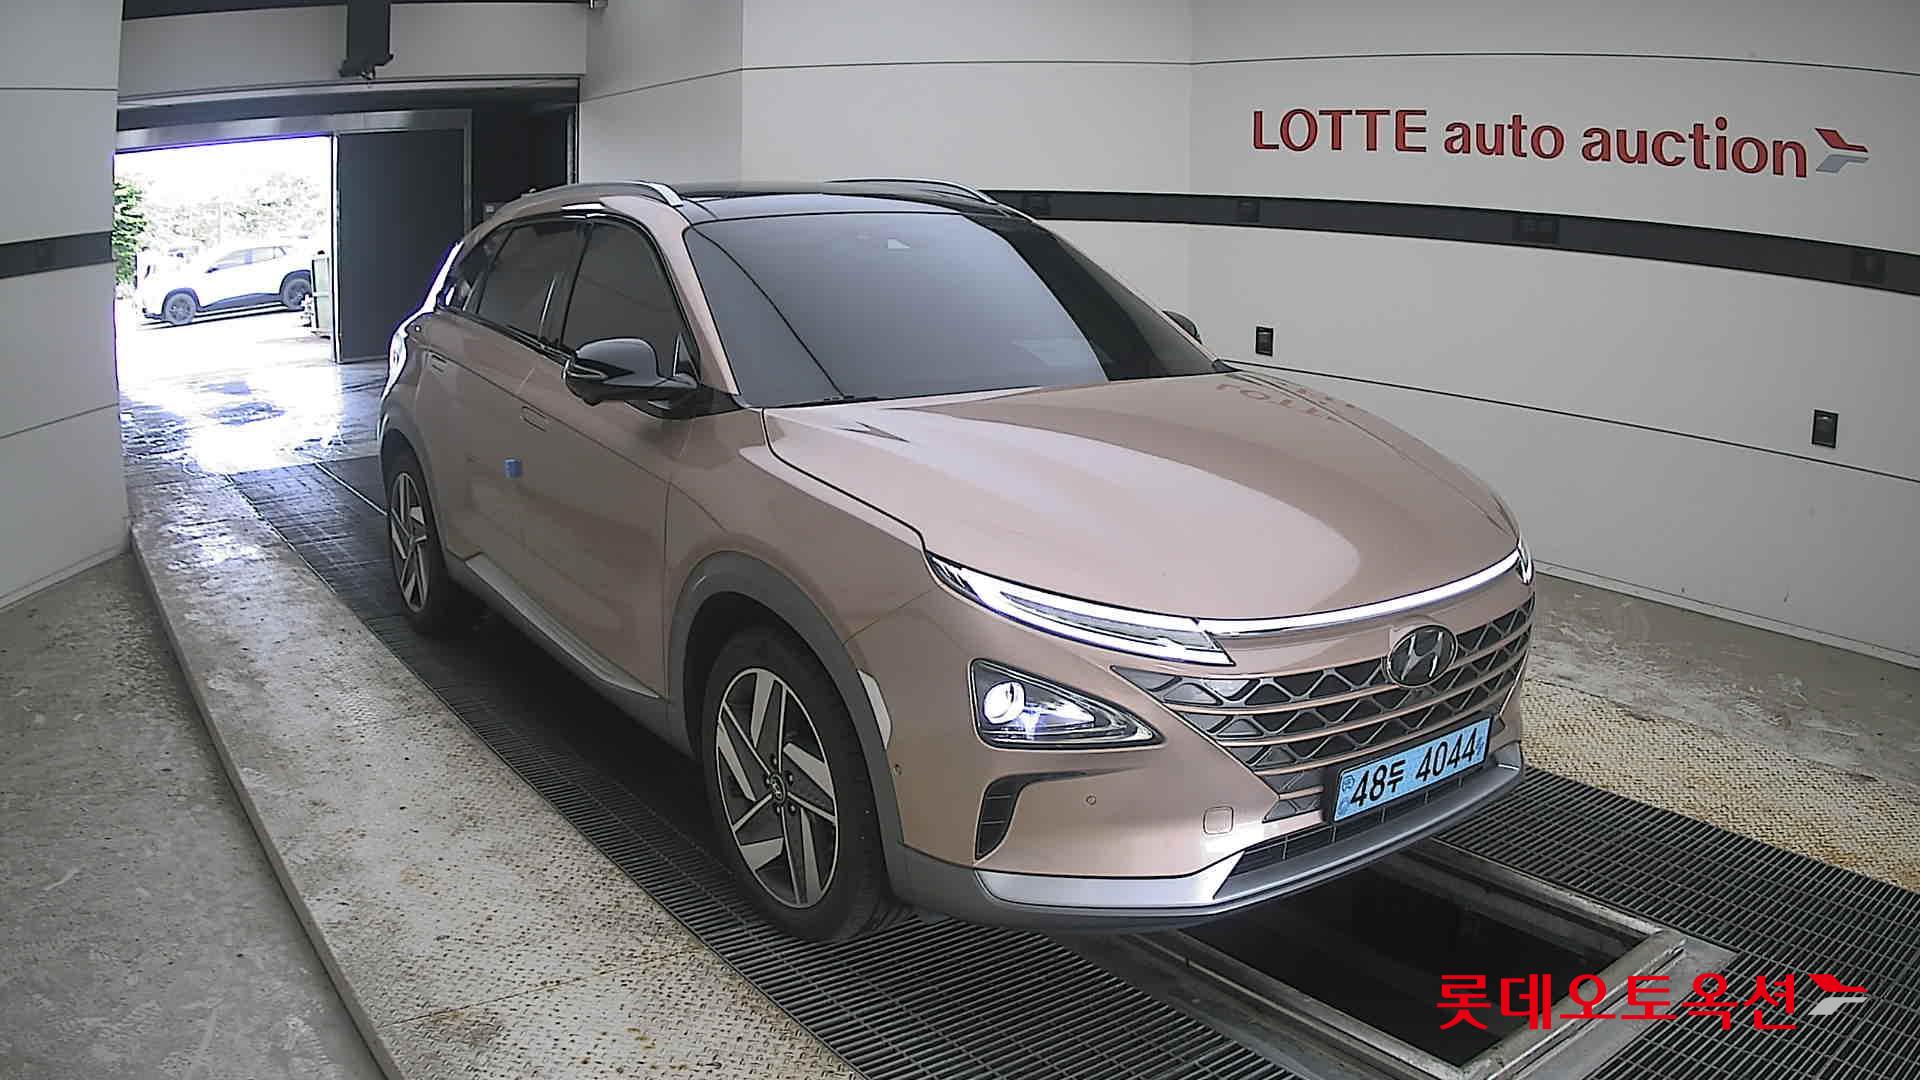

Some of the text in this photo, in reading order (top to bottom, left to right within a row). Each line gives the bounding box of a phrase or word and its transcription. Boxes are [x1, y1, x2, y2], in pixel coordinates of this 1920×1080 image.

[1252, 109, 1808, 179] LOTTE auto auction
[1350, 759, 1406, 807] 48두
[1415, 727, 1477, 782] 4044
